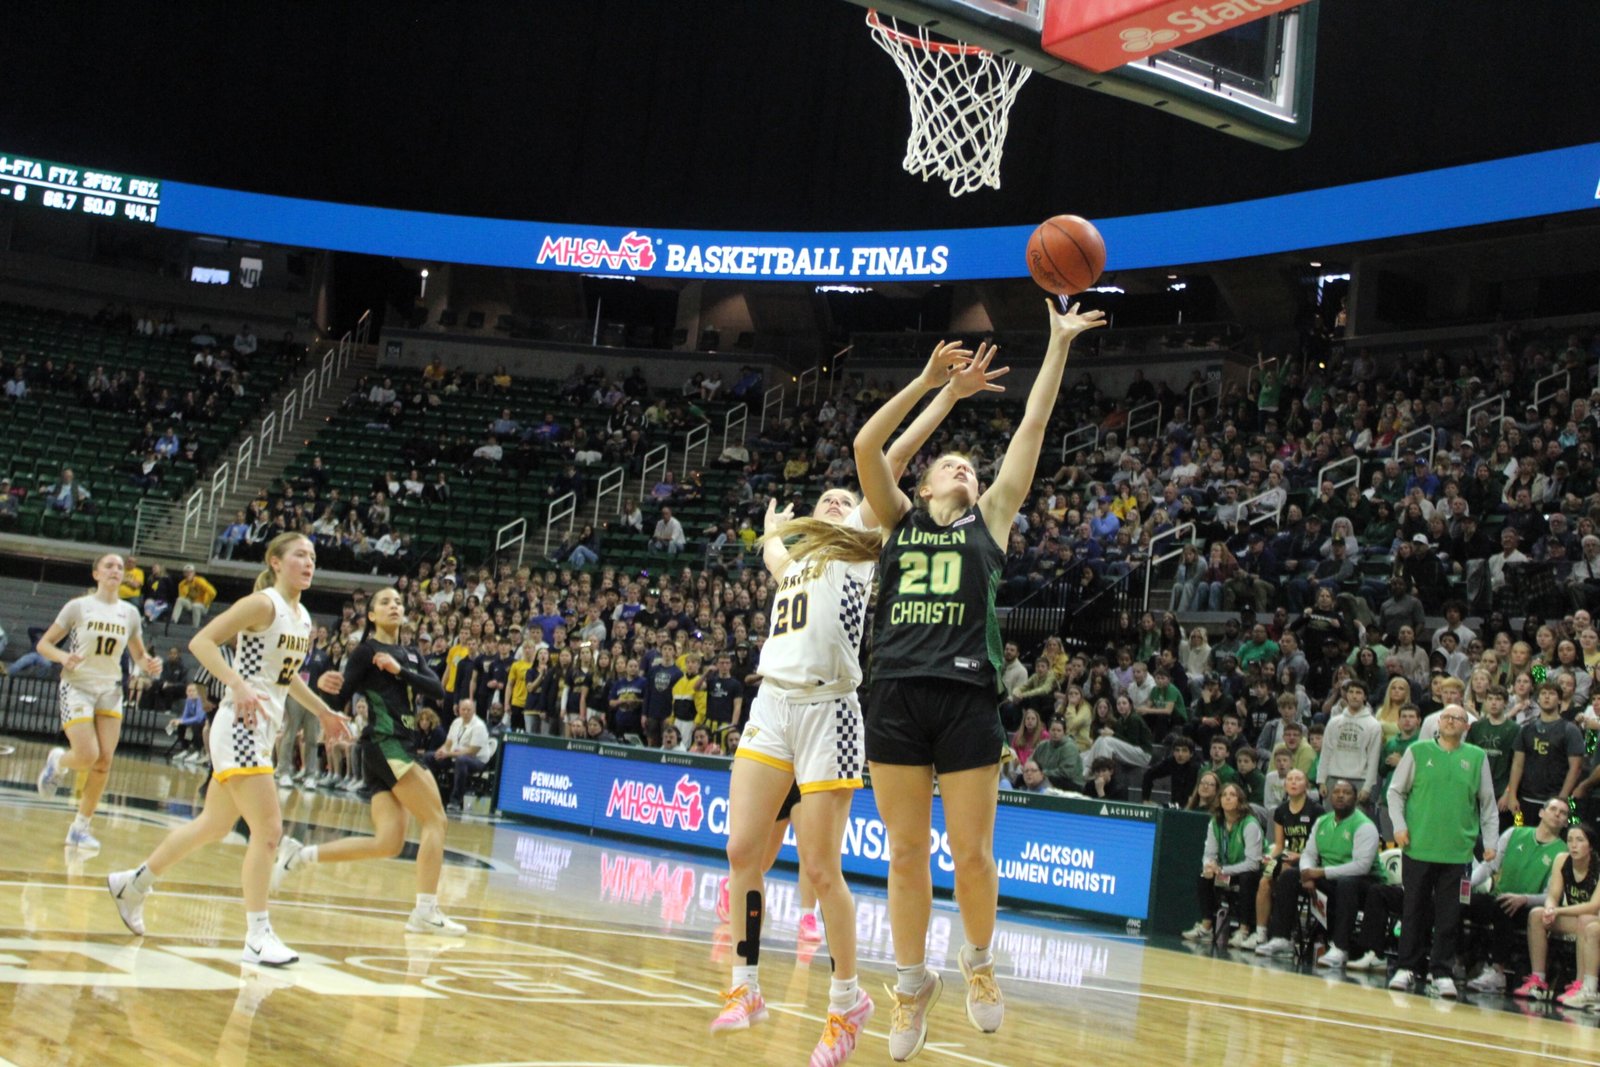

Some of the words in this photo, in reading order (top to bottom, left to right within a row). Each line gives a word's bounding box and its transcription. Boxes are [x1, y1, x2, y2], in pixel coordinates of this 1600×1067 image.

[48, 166, 78, 187] FT%
[129, 179, 158, 198] FG%
[125, 203, 157, 223] 44.1
[536, 235, 638, 270] MHSAA
[665, 245, 845, 277] BASKETBALL
[849, 245, 949, 276] FINALS
[897, 526, 966, 546] LUMEN
[898, 551, 962, 595] 20
[772, 591, 808, 637] 20
[890, 602, 965, 626] CHRISTI
[87, 621, 126, 636] PIRATES
[95, 635, 117, 657] 10
[277, 633, 309, 653] PIRATE
[530, 770, 573, 791] PEWAMO-
[522, 786, 578, 809] WESTPHALIA
[606, 777, 692, 829] MHSAA
[1110, 807, 1150, 819] ACRISURE
[1020, 841, 1094, 869] JACKSON
[997, 858, 1049, 886] LUMEN
[1052, 867, 1116, 895] CHRISTI
